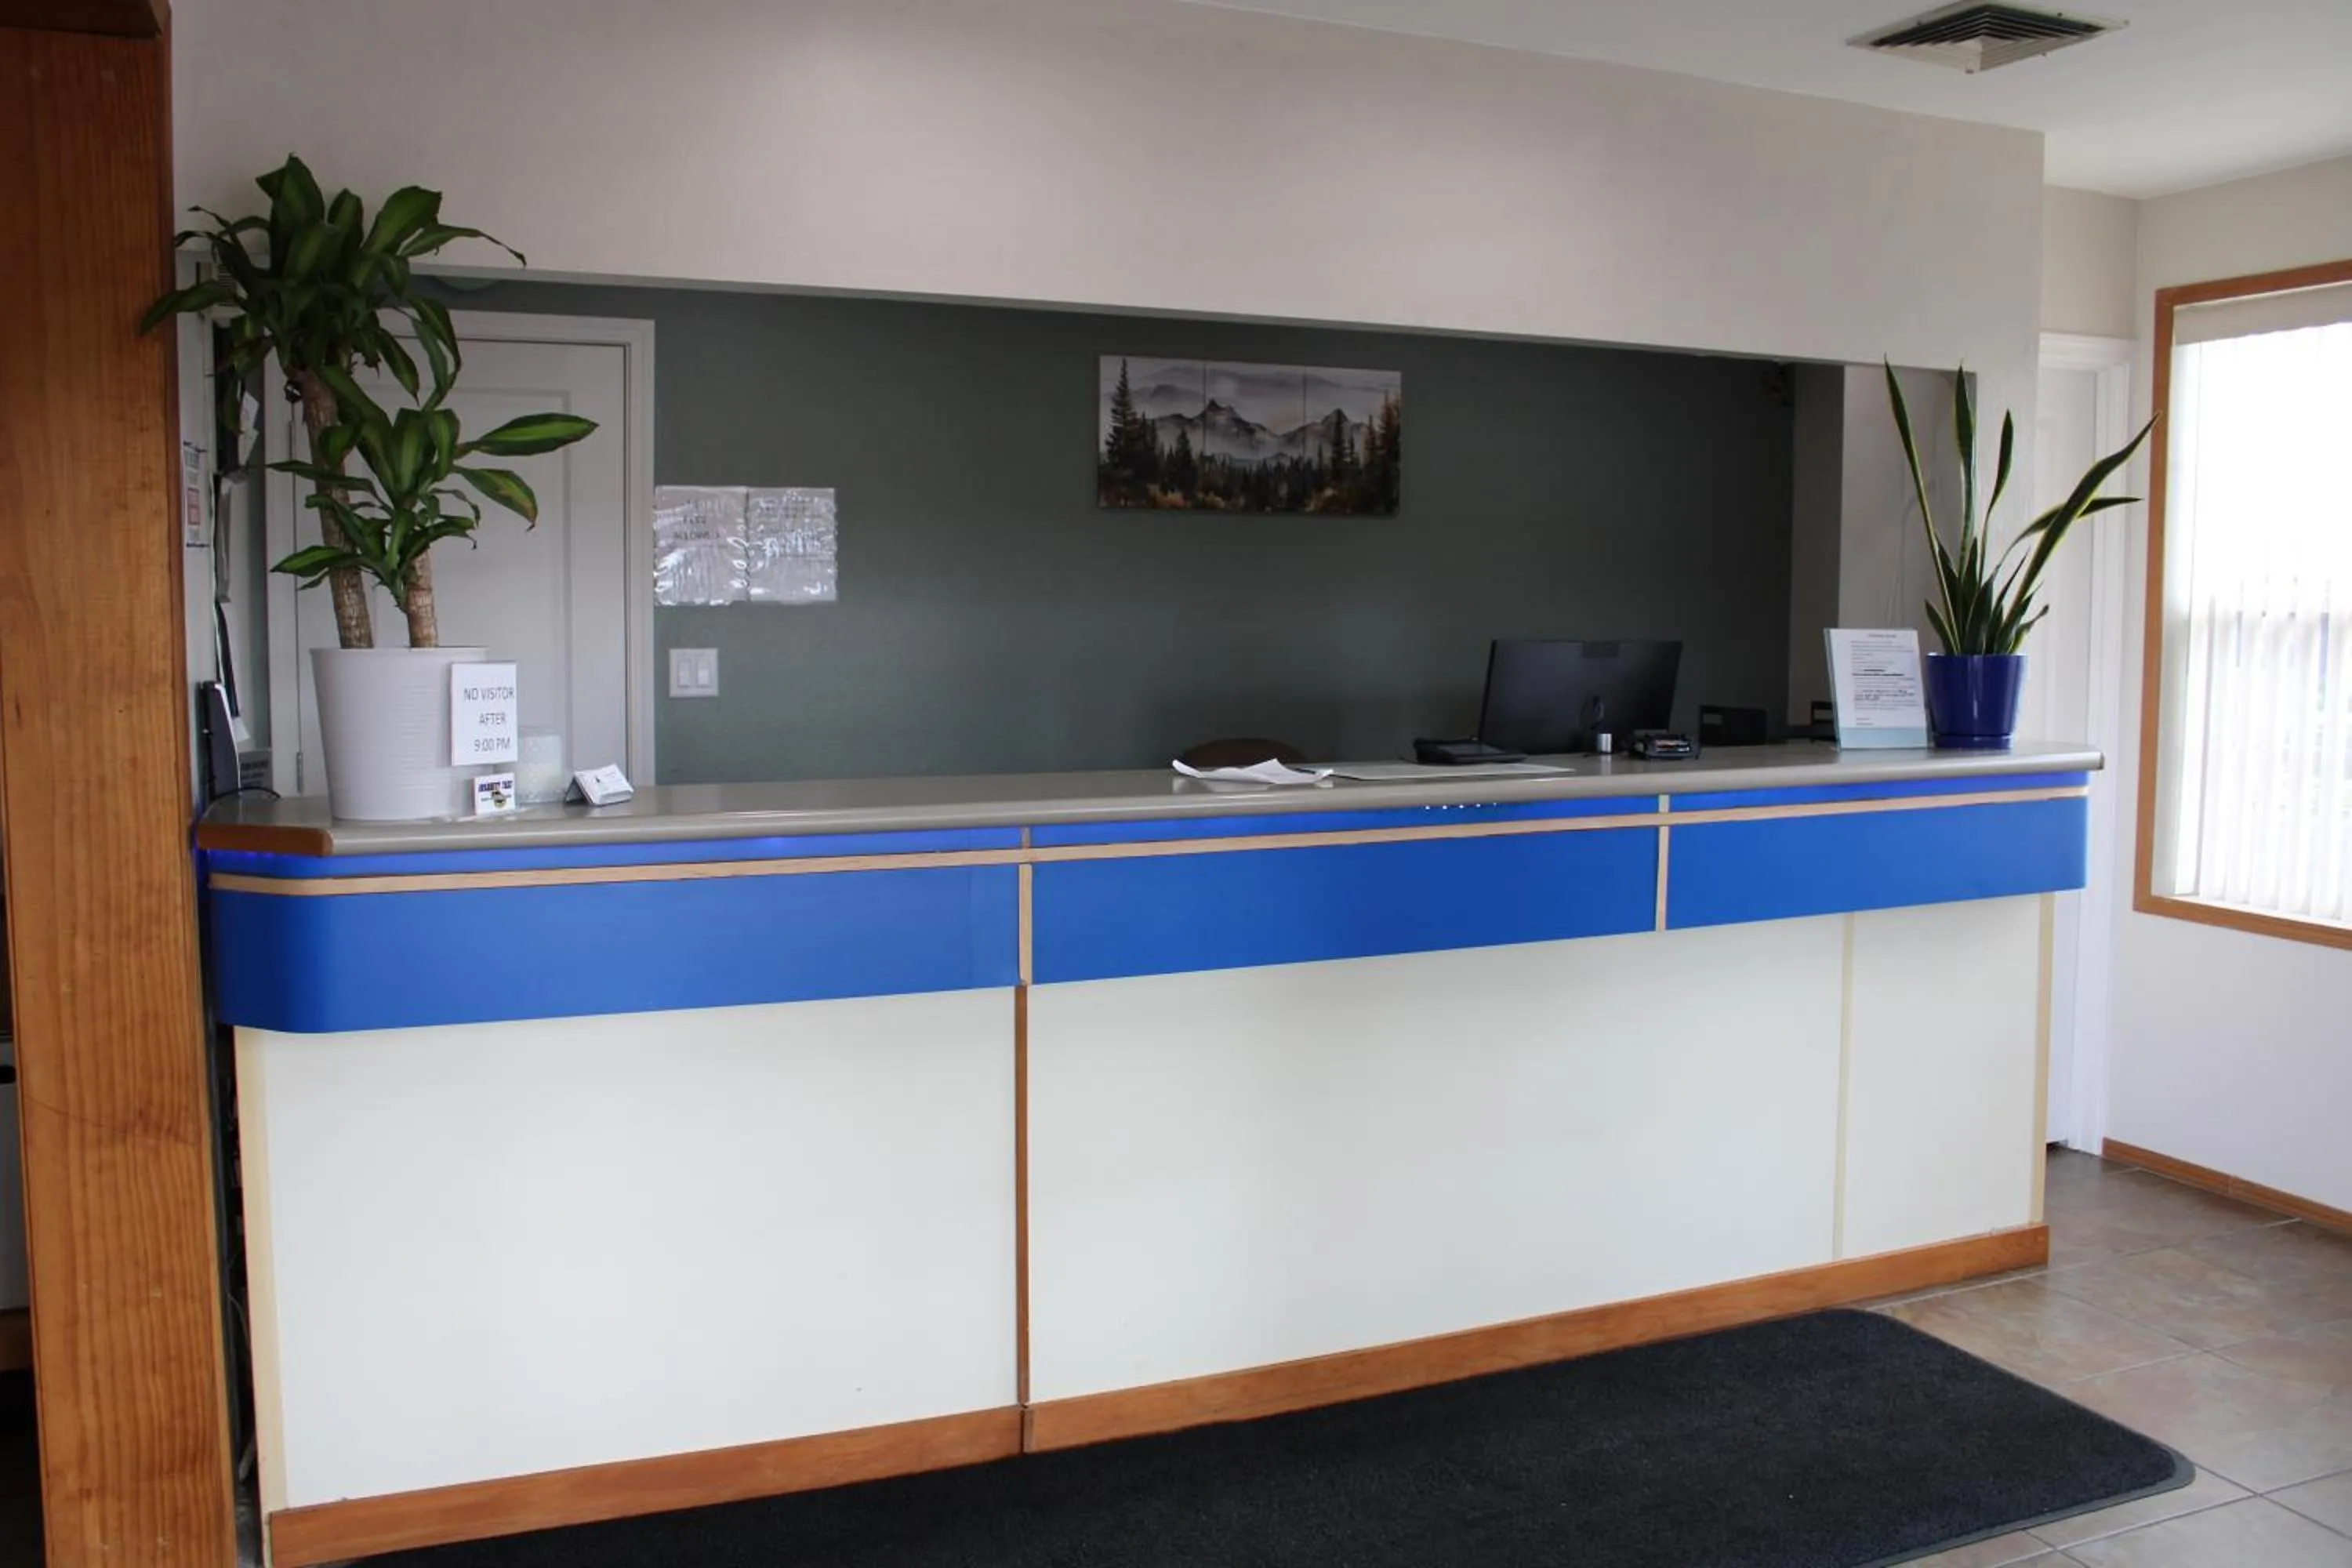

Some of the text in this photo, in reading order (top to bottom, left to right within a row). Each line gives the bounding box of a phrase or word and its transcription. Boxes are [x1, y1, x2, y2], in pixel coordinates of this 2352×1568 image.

[464, 687, 514, 701] NO VISITOR
[479, 713, 506, 725] AFTER
[474, 738, 510, 752] 9:00 PM
